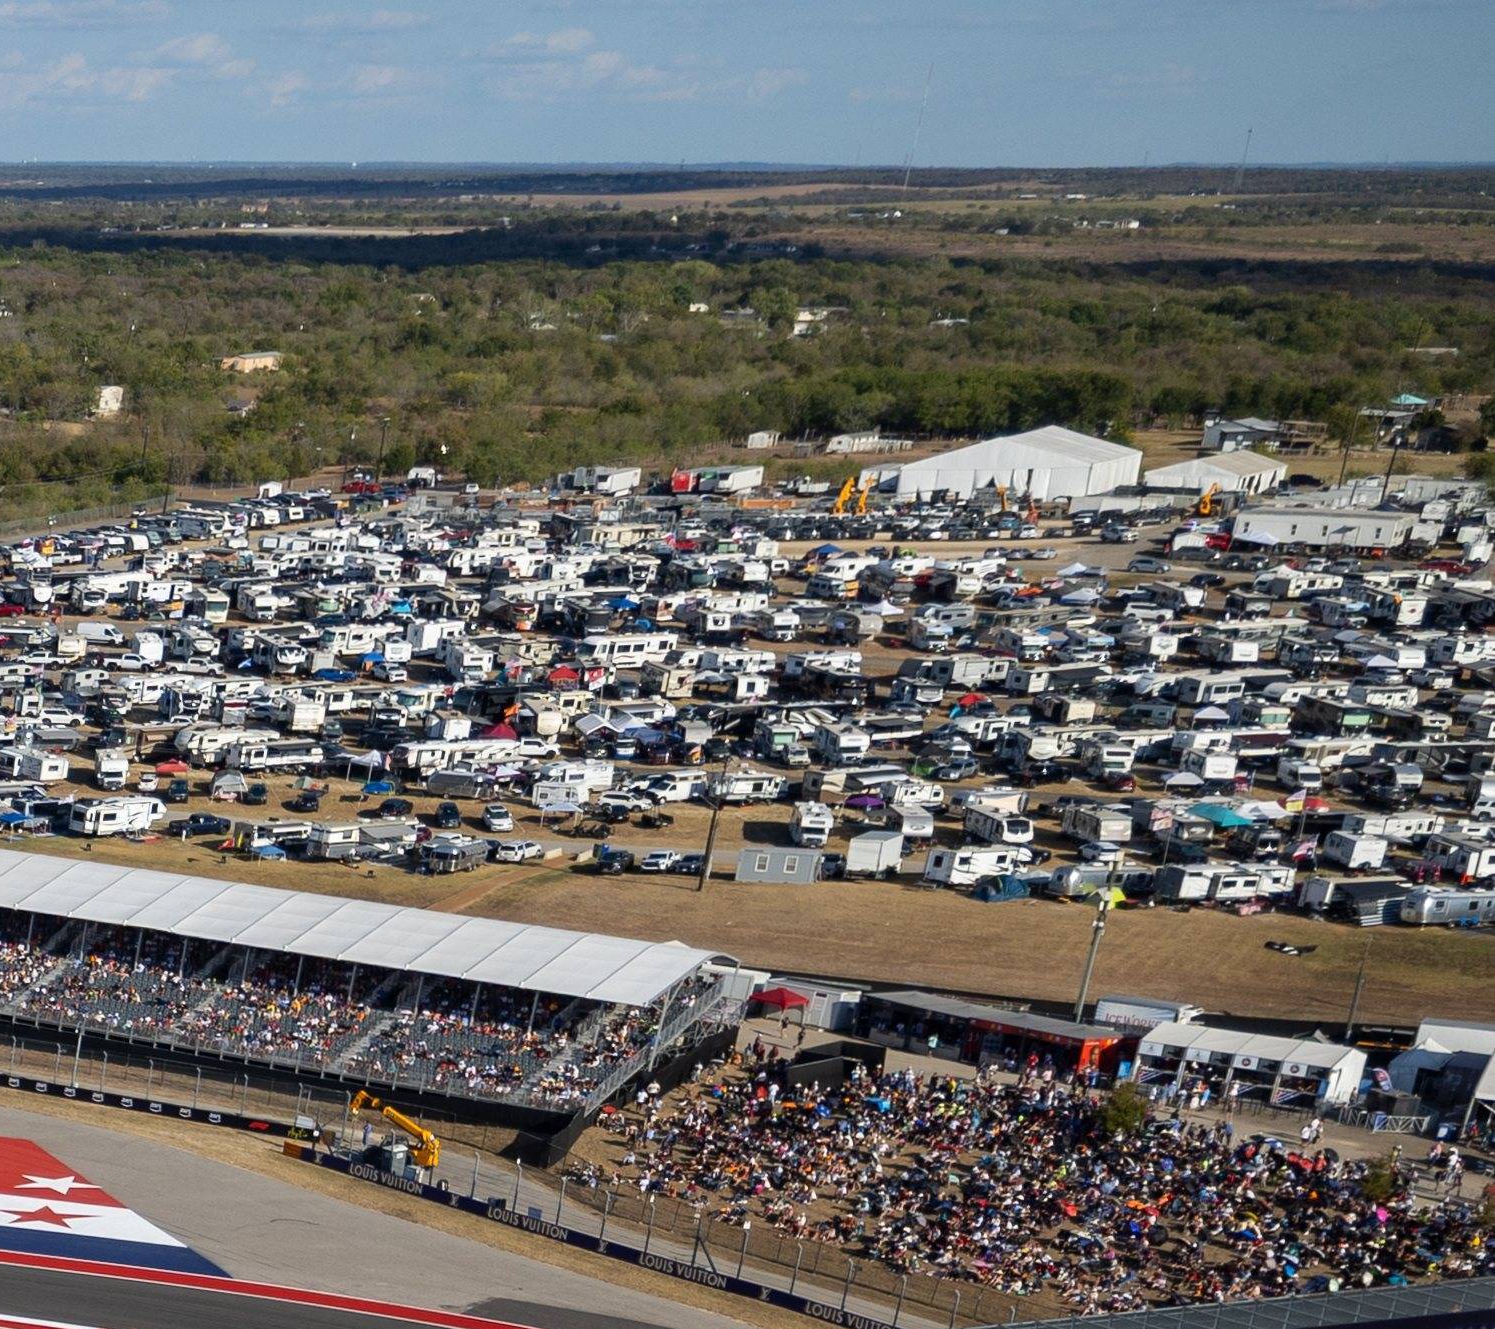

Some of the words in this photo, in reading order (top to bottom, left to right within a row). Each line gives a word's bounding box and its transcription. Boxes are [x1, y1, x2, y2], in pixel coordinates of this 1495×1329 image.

[348, 1163, 380, 1183] LOUIS
[380, 1168, 423, 1196] VUITTON
[486, 1205, 518, 1228] LOUIS
[519, 1213, 569, 1241] VUITTON
[639, 1252, 675, 1275] LOUIS
[676, 1261, 728, 1289] VUITTON
[804, 1300, 844, 1324] LOUIS
